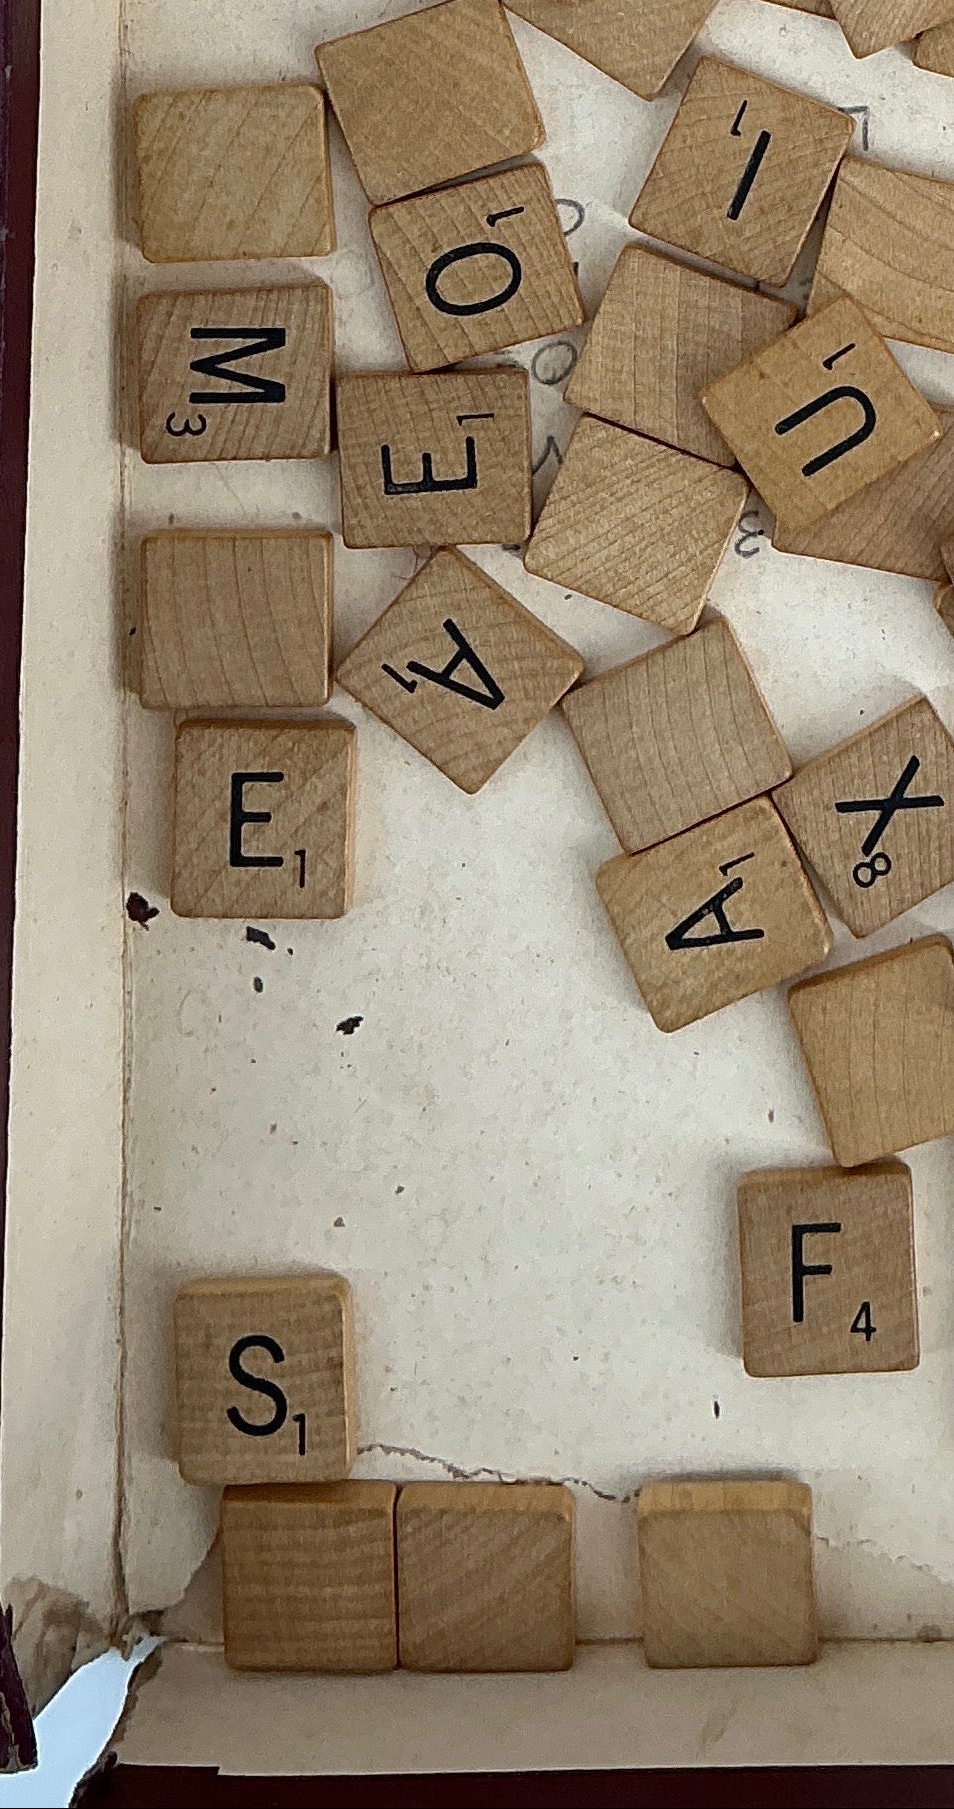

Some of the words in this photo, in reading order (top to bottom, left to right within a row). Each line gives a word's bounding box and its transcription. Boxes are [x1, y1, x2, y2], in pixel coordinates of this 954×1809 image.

[729, 98, 749, 138] 1
[725, 129, 773, 222] I
[424, 241, 523, 318] O
[484, 205, 526, 229] 1
[187, 326, 288, 406] M
[821, 342, 857, 372] 1
[164, 410, 208, 438] 3
[379, 435, 479, 497] E
[455, 411, 496, 428] 1
[773, 384, 878, 478] U
[379, 662, 419, 695] 1
[404, 617, 507, 712] A
[228, 770, 286, 869] E
[292, 848, 308, 890] 1
[833, 753, 947, 859] X
[663, 875, 766, 952] A
[717, 851, 756, 878] 1
[851, 850, 893, 890] 8
[790, 1220, 843, 1324] F
[849, 1300, 878, 1343] 4
[225, 1333, 289, 1438] S
[291, 1411, 307, 1457] 1
